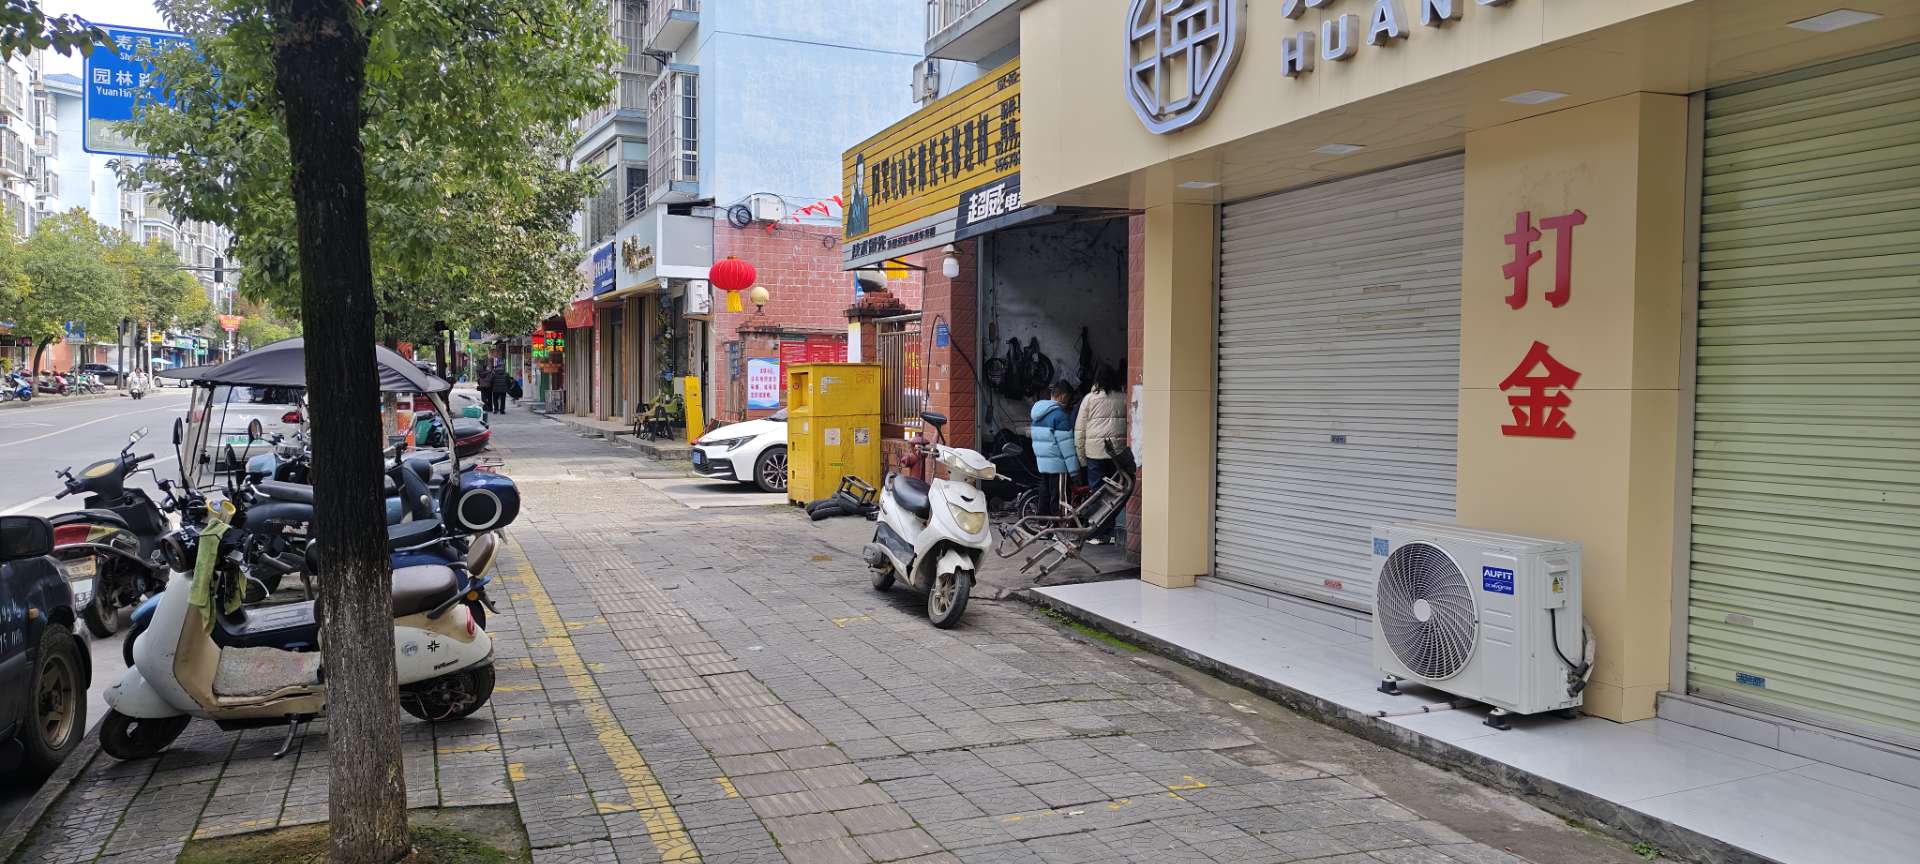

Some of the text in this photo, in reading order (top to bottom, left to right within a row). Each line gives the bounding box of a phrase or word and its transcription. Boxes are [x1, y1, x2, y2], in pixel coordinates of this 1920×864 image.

[1281, 0, 1514, 78] HUAN
[96, 86, 132, 98] Yuanlin
[967, 182, 1025, 224] 超威电
[1498, 209, 1587, 440] 打金
[1484, 569, 1513, 580] AUFIT
